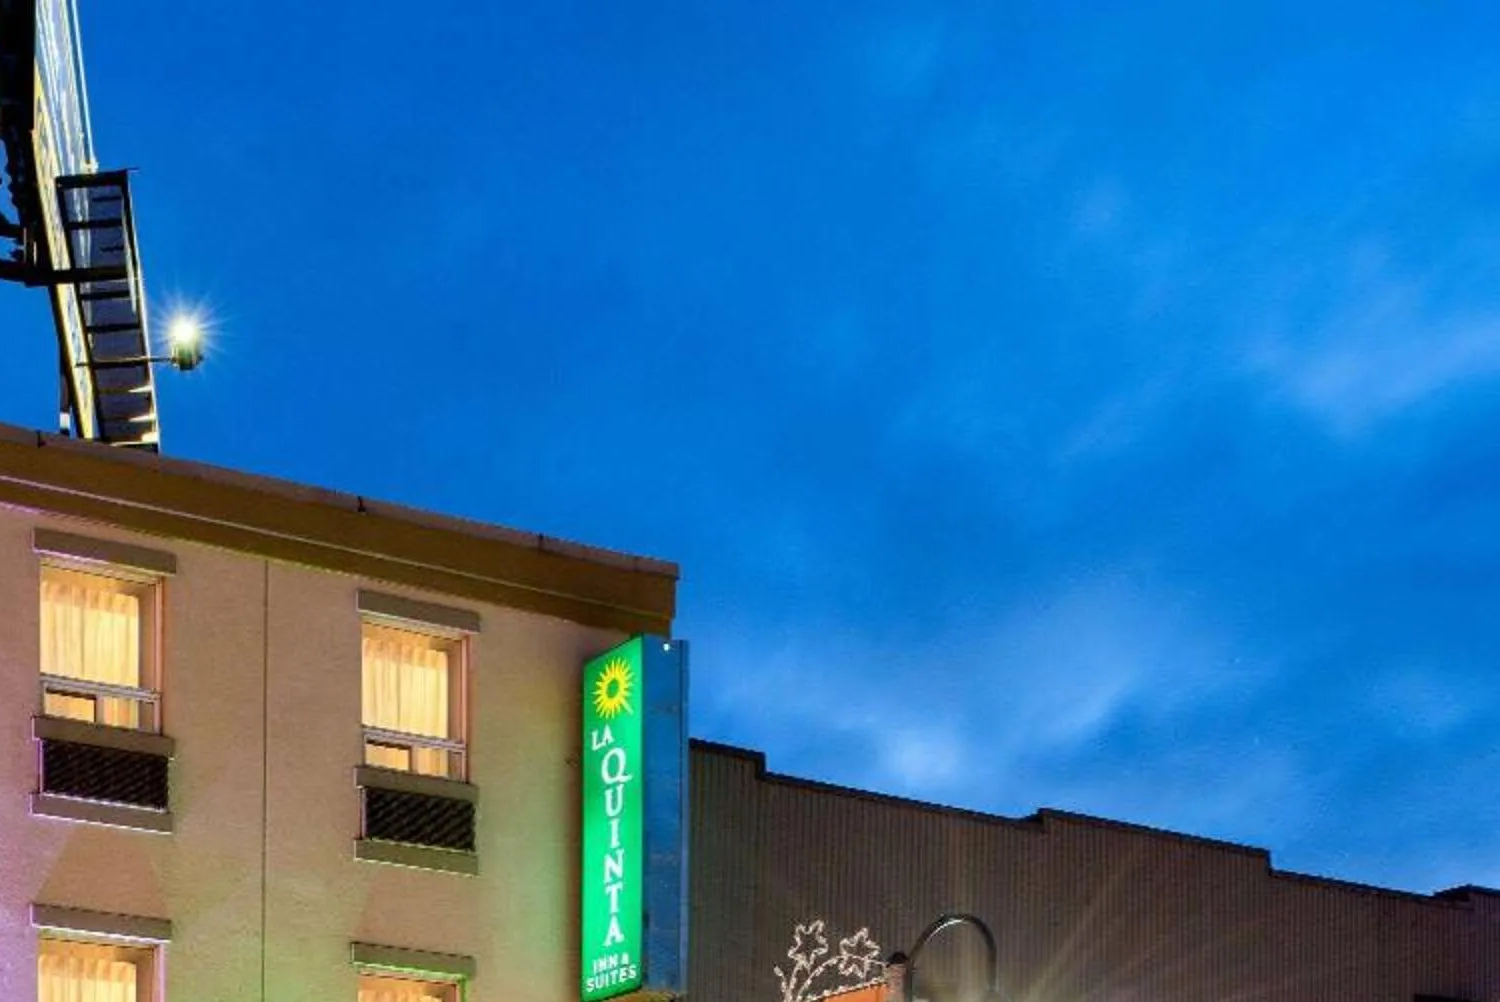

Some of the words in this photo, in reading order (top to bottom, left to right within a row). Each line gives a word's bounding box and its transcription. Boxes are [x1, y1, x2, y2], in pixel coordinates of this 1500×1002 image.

[591, 724, 615, 751] LA
[600, 747, 633, 947] QUINTA
[586, 964, 637, 993] SUITES
[592, 953, 619, 977] INN
